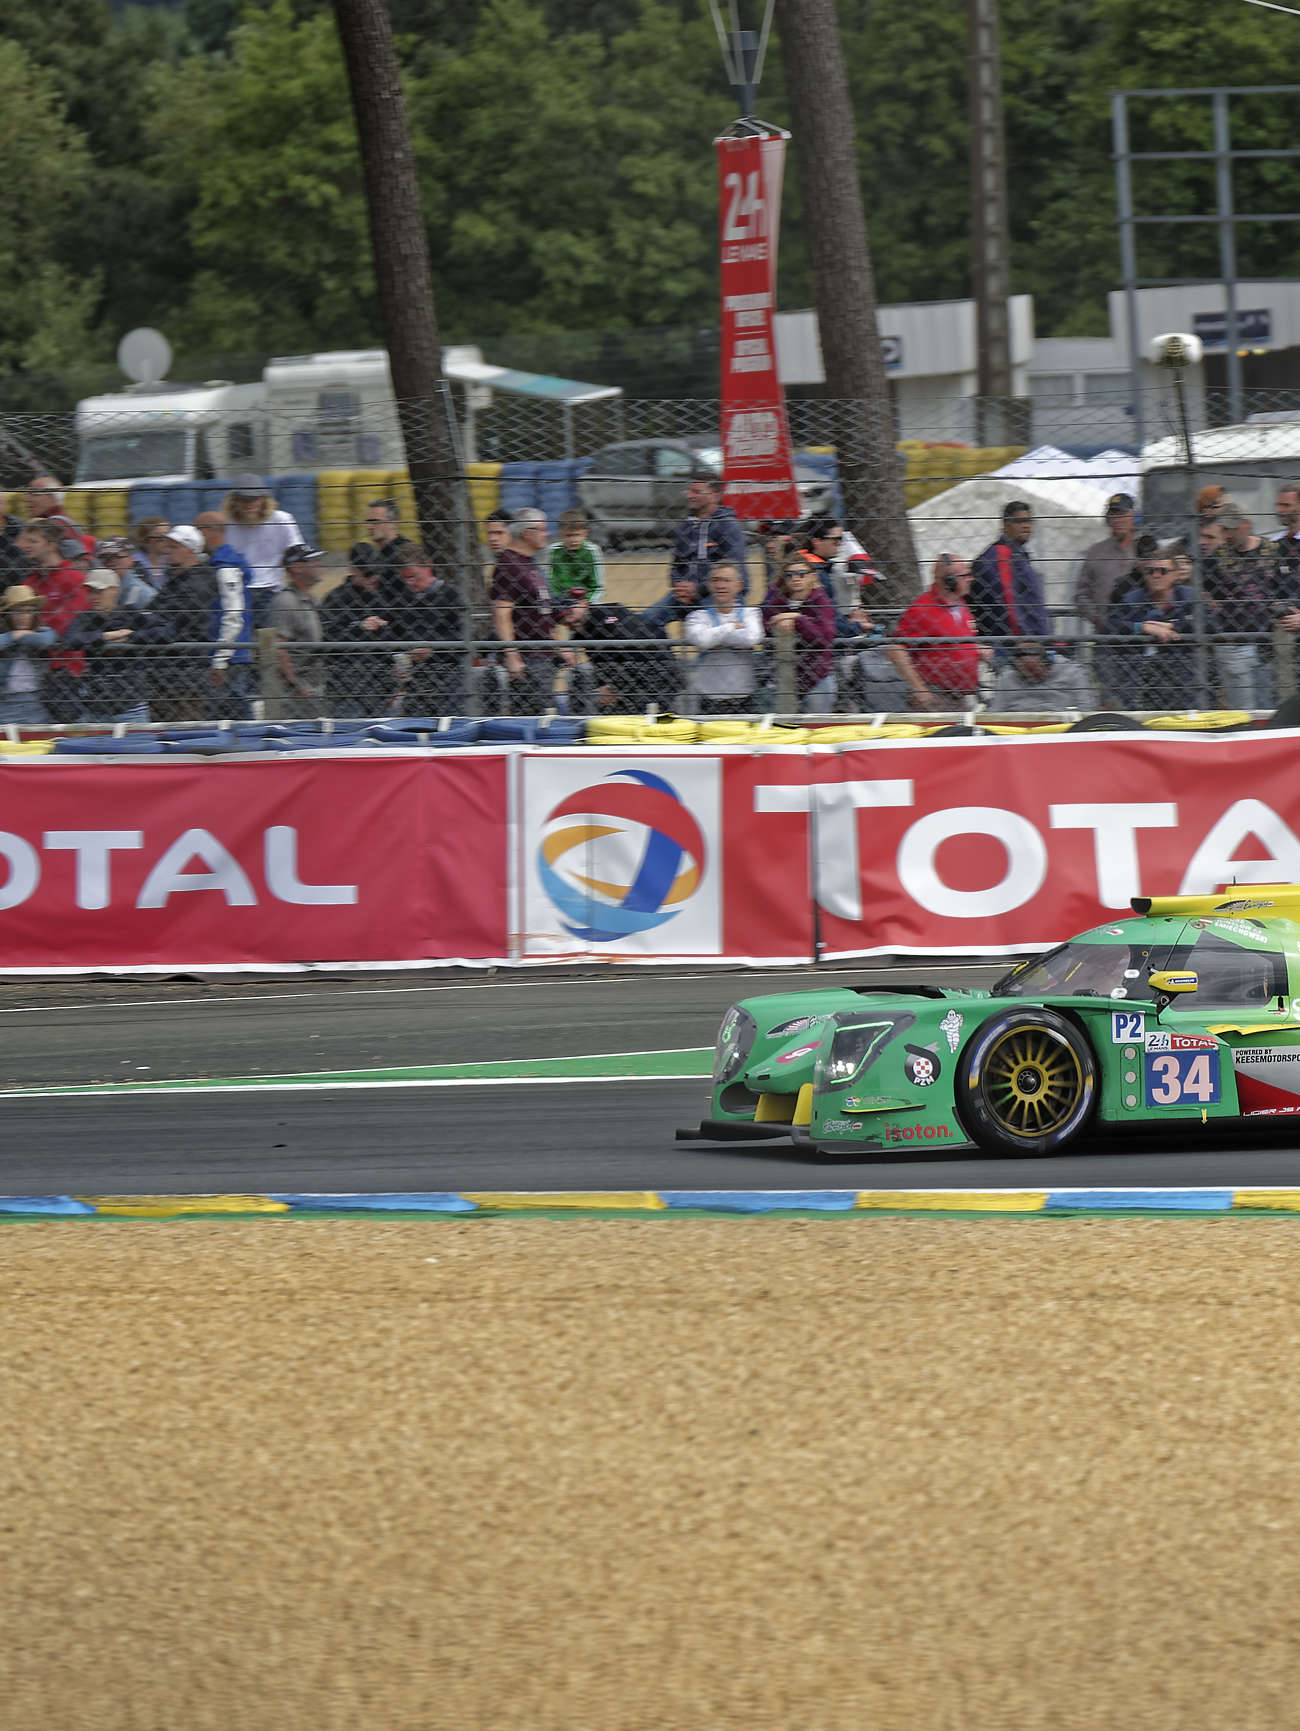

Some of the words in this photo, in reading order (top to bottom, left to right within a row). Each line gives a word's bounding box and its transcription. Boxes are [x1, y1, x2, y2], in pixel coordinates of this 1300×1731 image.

[1116, 1014, 1142, 1038] P2
[1173, 1037, 1218, 1048] TOTAL
[914, 1076, 935, 1086] PZM
[1152, 1055, 1214, 1104] 34
